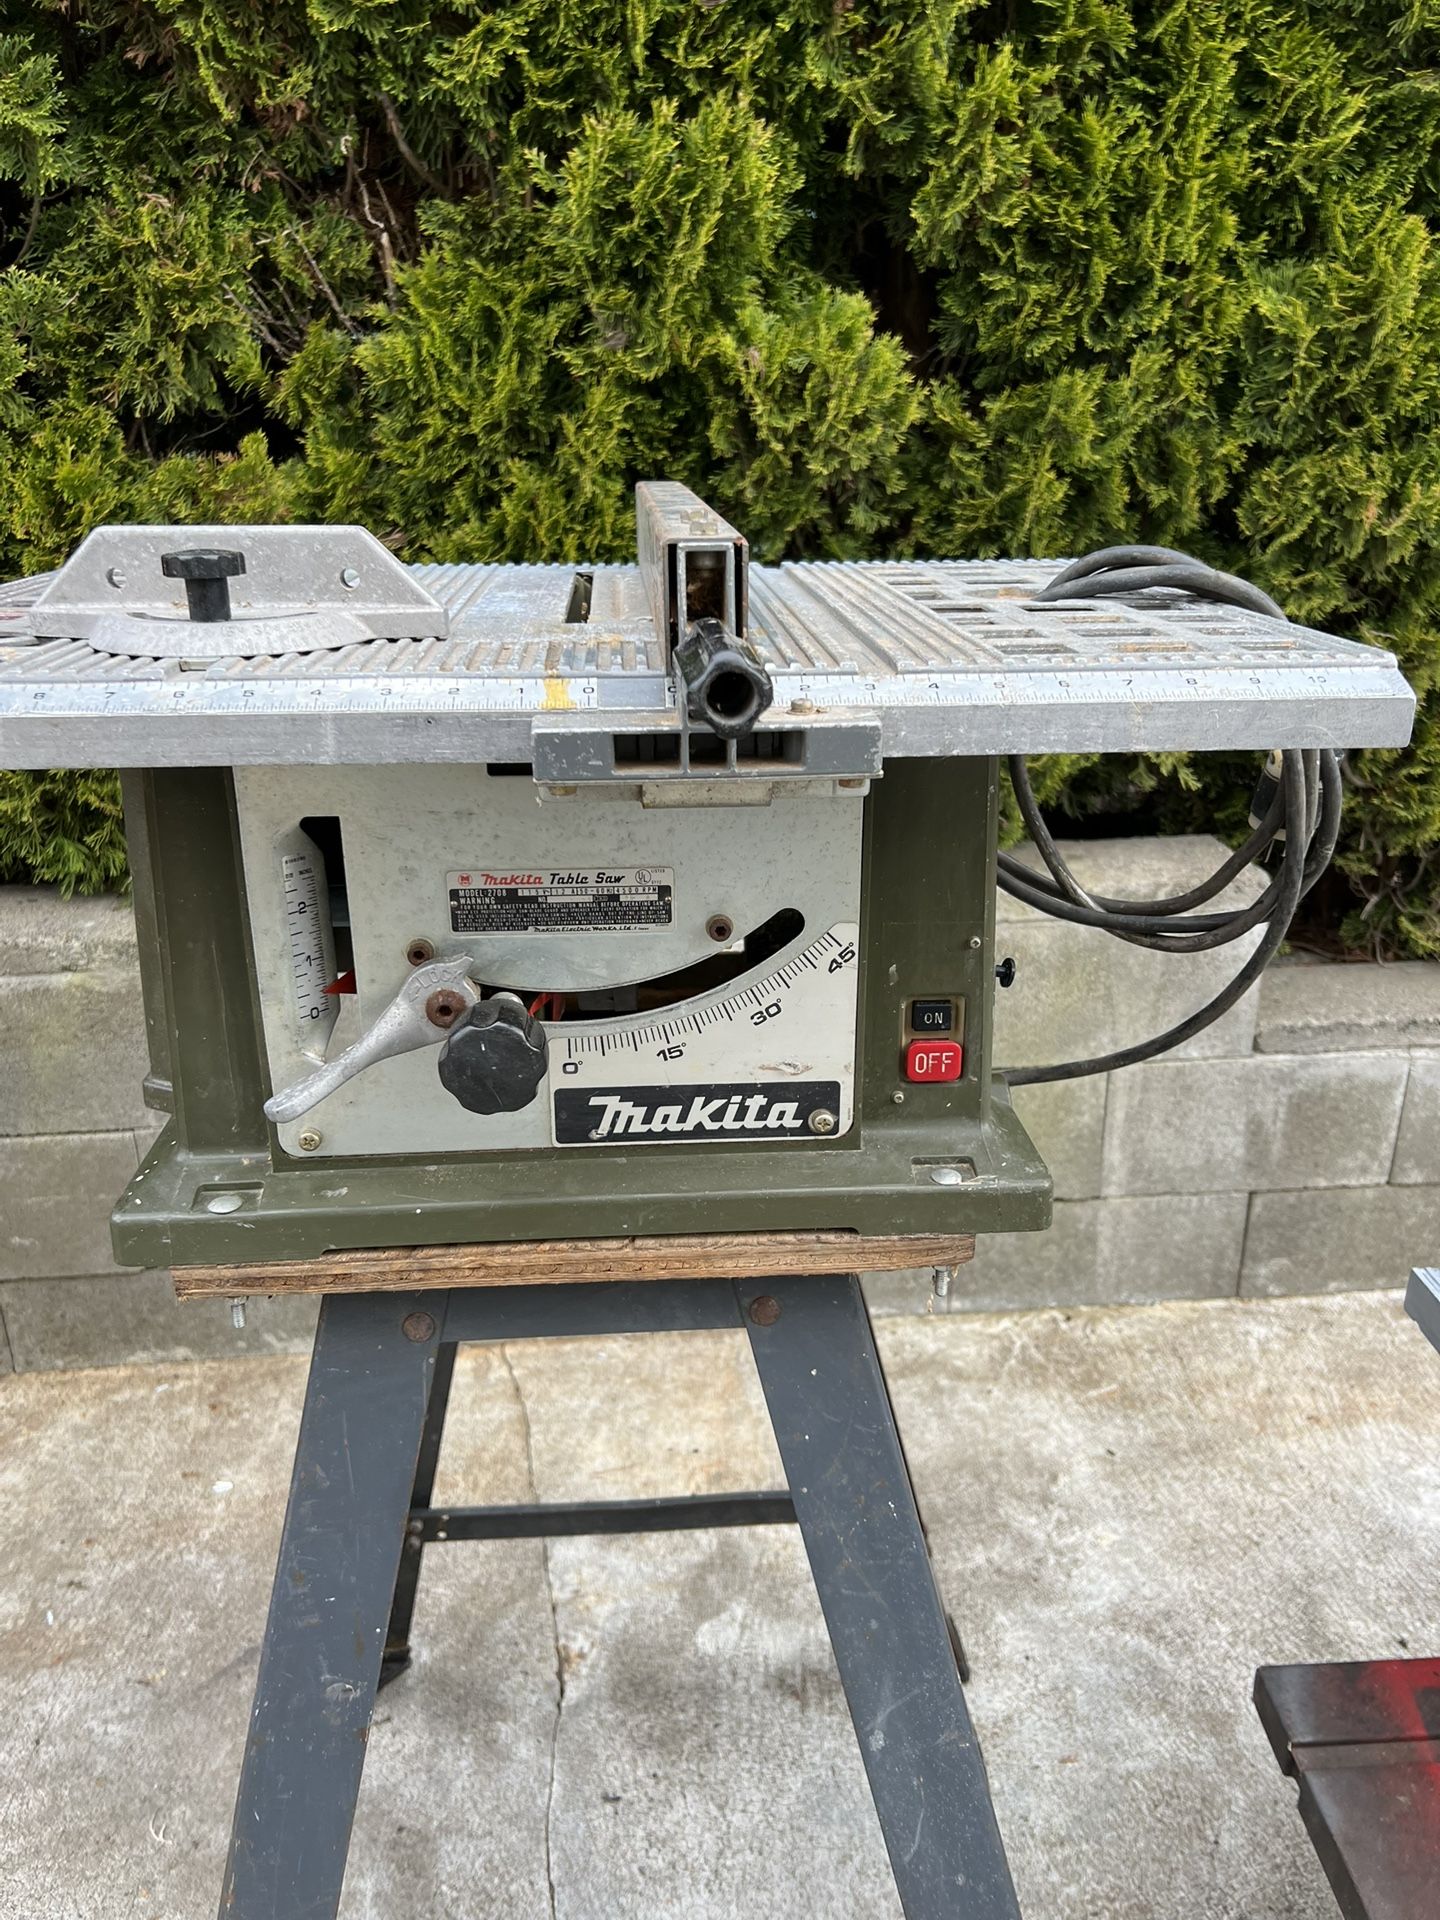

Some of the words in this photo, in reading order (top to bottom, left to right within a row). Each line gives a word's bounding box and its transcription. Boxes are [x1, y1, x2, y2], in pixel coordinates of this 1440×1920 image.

[1058, 679, 1070, 688] 6
[1185, 677, 1199, 686] 8
[1250, 676, 1262, 685] 9
[1308, 675, 1328, 684] 10
[379, 688, 392, 696] 3
[582, 687, 595, 695] 0
[481, 873, 544, 886] Makita
[549, 872, 589, 885] Table
[595, 871, 626, 884] Saw
[460, 896, 496, 905] WARNING
[298, 901, 308, 914] 2
[305, 955, 313, 967] 1
[310, 1006, 320, 1019] 0
[924, 1012, 943, 1024] ON
[915, 1052, 955, 1073] OFF
[588, 1095, 804, 1135] Makita
